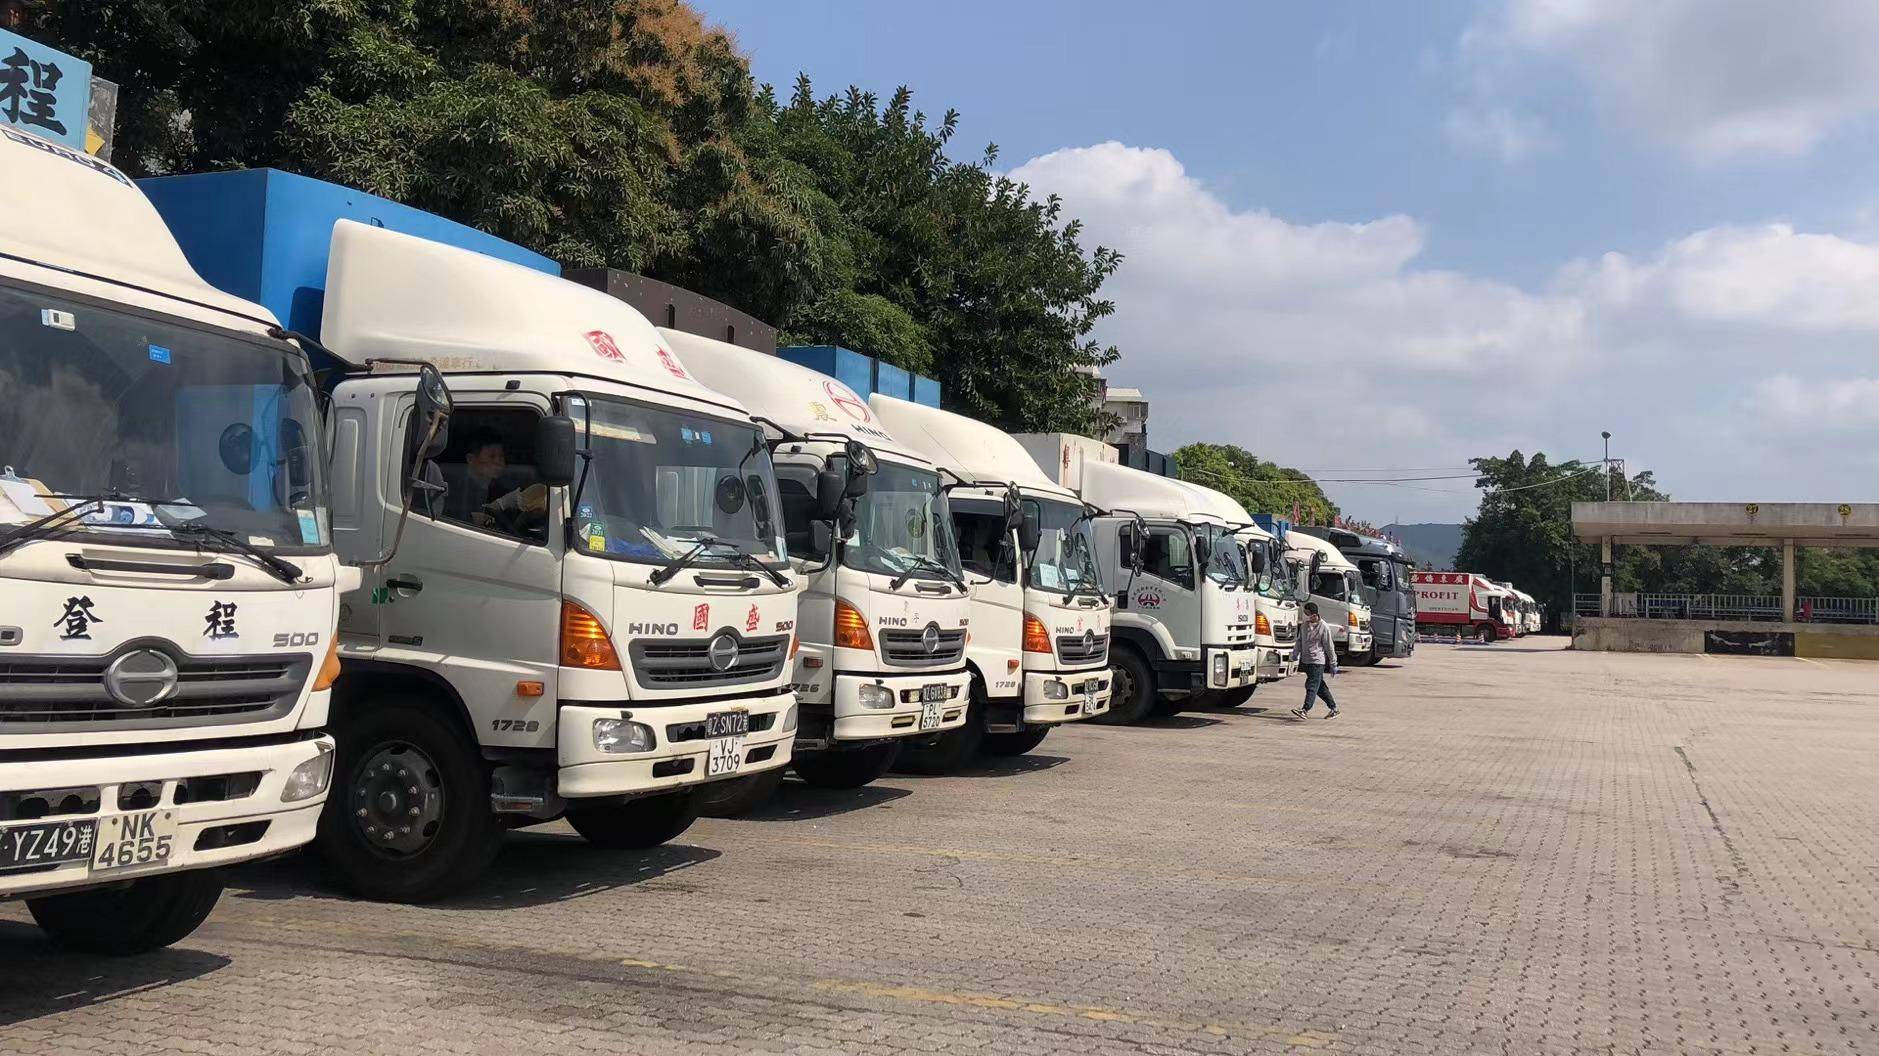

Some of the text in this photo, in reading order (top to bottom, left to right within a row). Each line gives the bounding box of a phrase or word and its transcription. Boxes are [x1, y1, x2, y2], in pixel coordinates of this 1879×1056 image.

[0, 47, 67, 136] 程
[53, 596, 103, 640] 登
[203, 600, 239, 639] 程
[879, 616, 907, 627] HINO
[628, 622, 679, 636] HINO
[776, 621, 793, 632] 500
[1055, 626, 1075, 634] HINO
[273, 632, 319, 648] 500
[492, 719, 539, 732] 1728
[720, 738, 734, 755] VJ
[711, 753, 741, 773] 3709
[120, 812, 157, 841] NK
[98, 834, 173, 867] 4655
